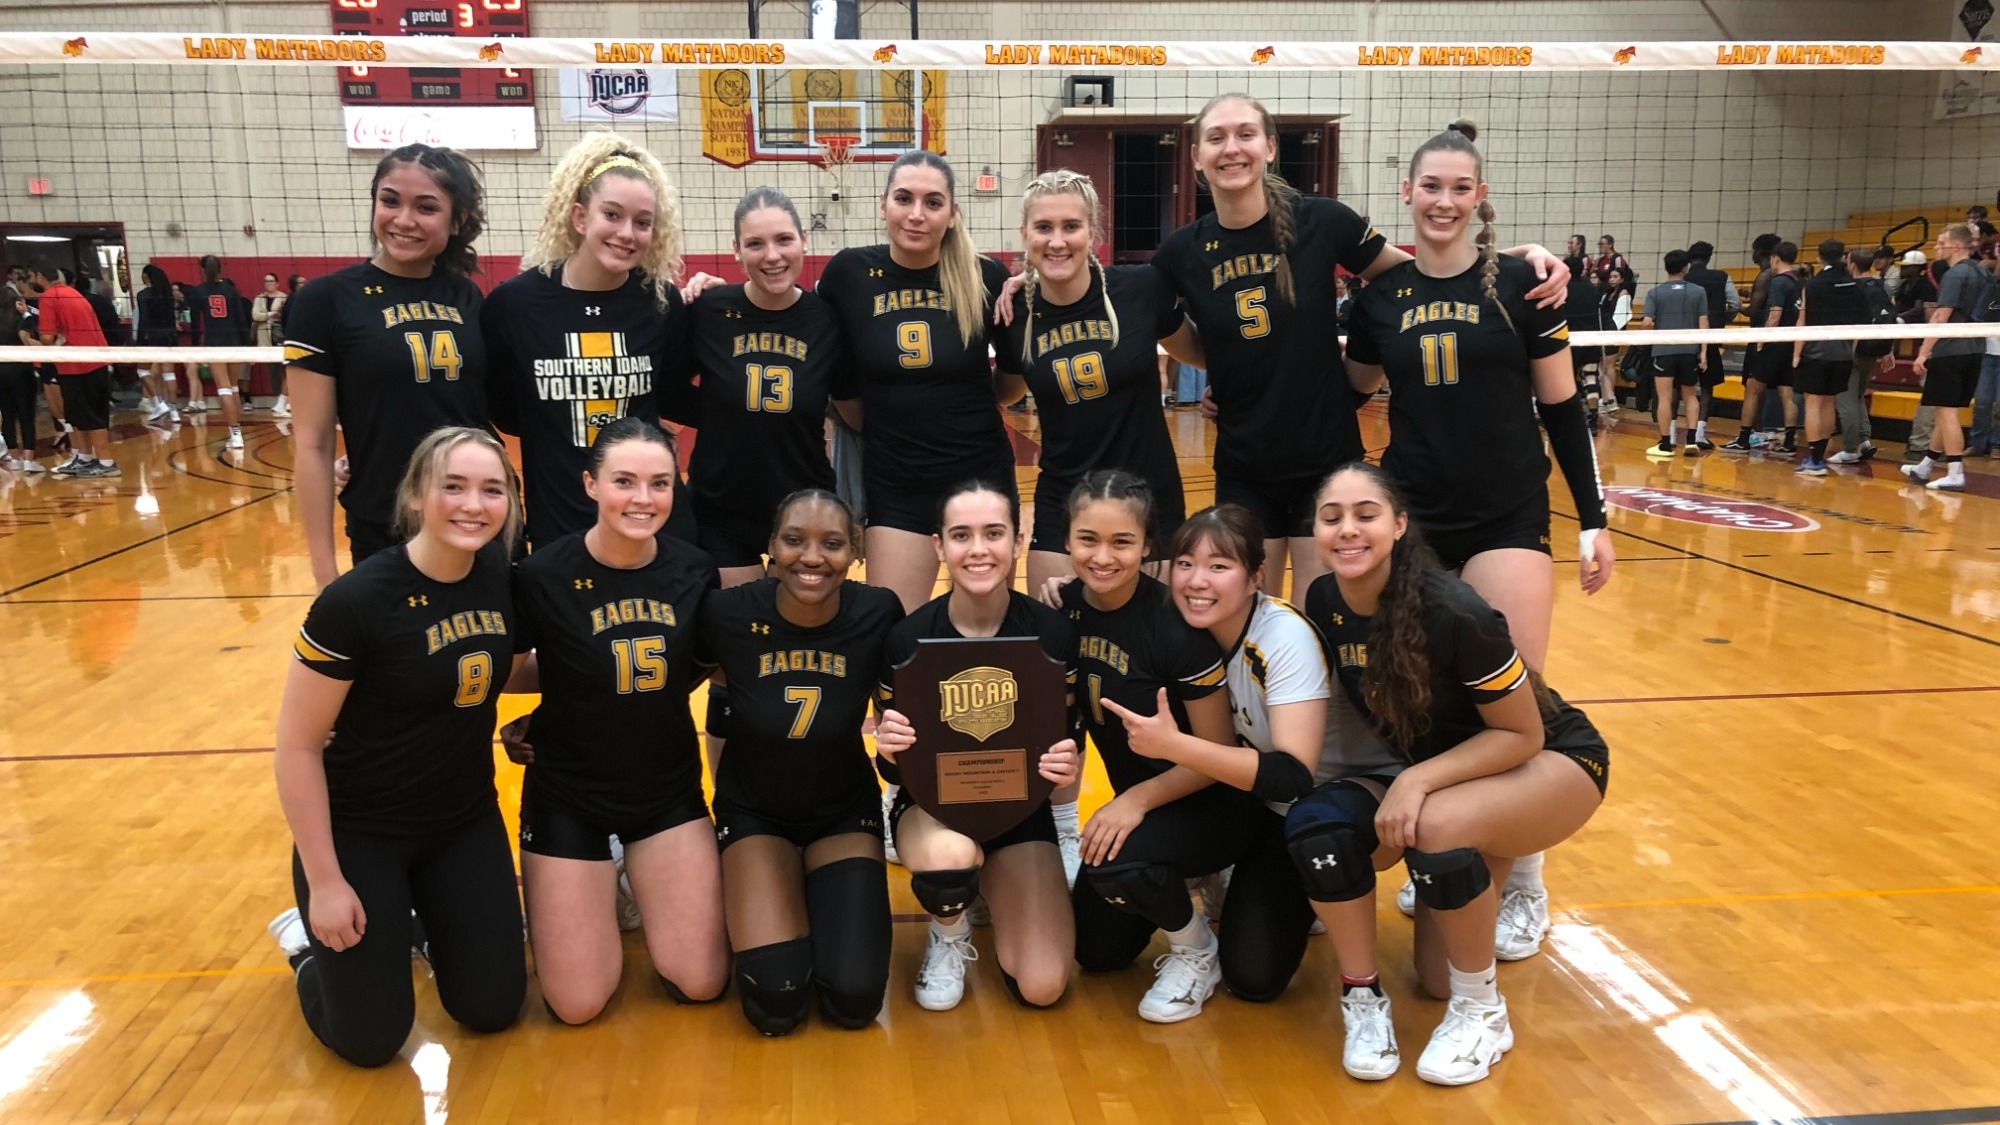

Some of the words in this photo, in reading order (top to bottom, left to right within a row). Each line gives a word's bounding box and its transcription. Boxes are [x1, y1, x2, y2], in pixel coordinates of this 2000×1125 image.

[411, 9, 448, 25] period
[458, 4, 474, 28] 3
[184, 38, 247, 60] LADY
[253, 40, 387, 62] MATADORS
[595, 43, 654, 64] LADY
[662, 43, 785, 64] MATADORS
[985, 45, 1042, 65] LADY
[1049, 45, 1167, 66] MATADORS
[1358, 46, 1413, 66] LADY
[1419, 46, 1533, 67] MATADORS
[1717, 45, 1772, 65] LADY
[1775, 45, 1885, 65] MATADORS
[349, 84, 372, 96] won
[421, 85, 450, 99] game
[501, 86, 522, 97] won
[590, 74, 650, 103] NJCAA
[710, 109, 747, 118] NATION
[208, 295, 228, 318] 9
[382, 300, 464, 329] EAGLES
[1235, 286, 1272, 340] 5
[1399, 301, 1480, 333] EAGLES
[732, 332, 808, 361] EAGLES
[897, 321, 933, 369] 9
[1036, 319, 1114, 358] EAGLES
[404, 330, 463, 383] 14
[534, 358, 613, 377] SOUTHERN
[1420, 332, 1459, 386] 11
[746, 363, 794, 413] 13
[1052, 351, 1109, 404] 19
[1607, 488, 1793, 528] CHAPMAN
[590, 598, 677, 635] EAGLES
[425, 610, 507, 655] EAGLES
[612, 635, 668, 694] 15
[758, 649, 846, 677] EAGLES
[1079, 635, 1130, 675] AGLES
[1337, 643, 1369, 667] EAG
[454, 651, 493, 707] 8
[785, 686, 821, 739] 7
[943, 681, 1015, 717] NJCAA
[1088, 673, 1105, 725] 1
